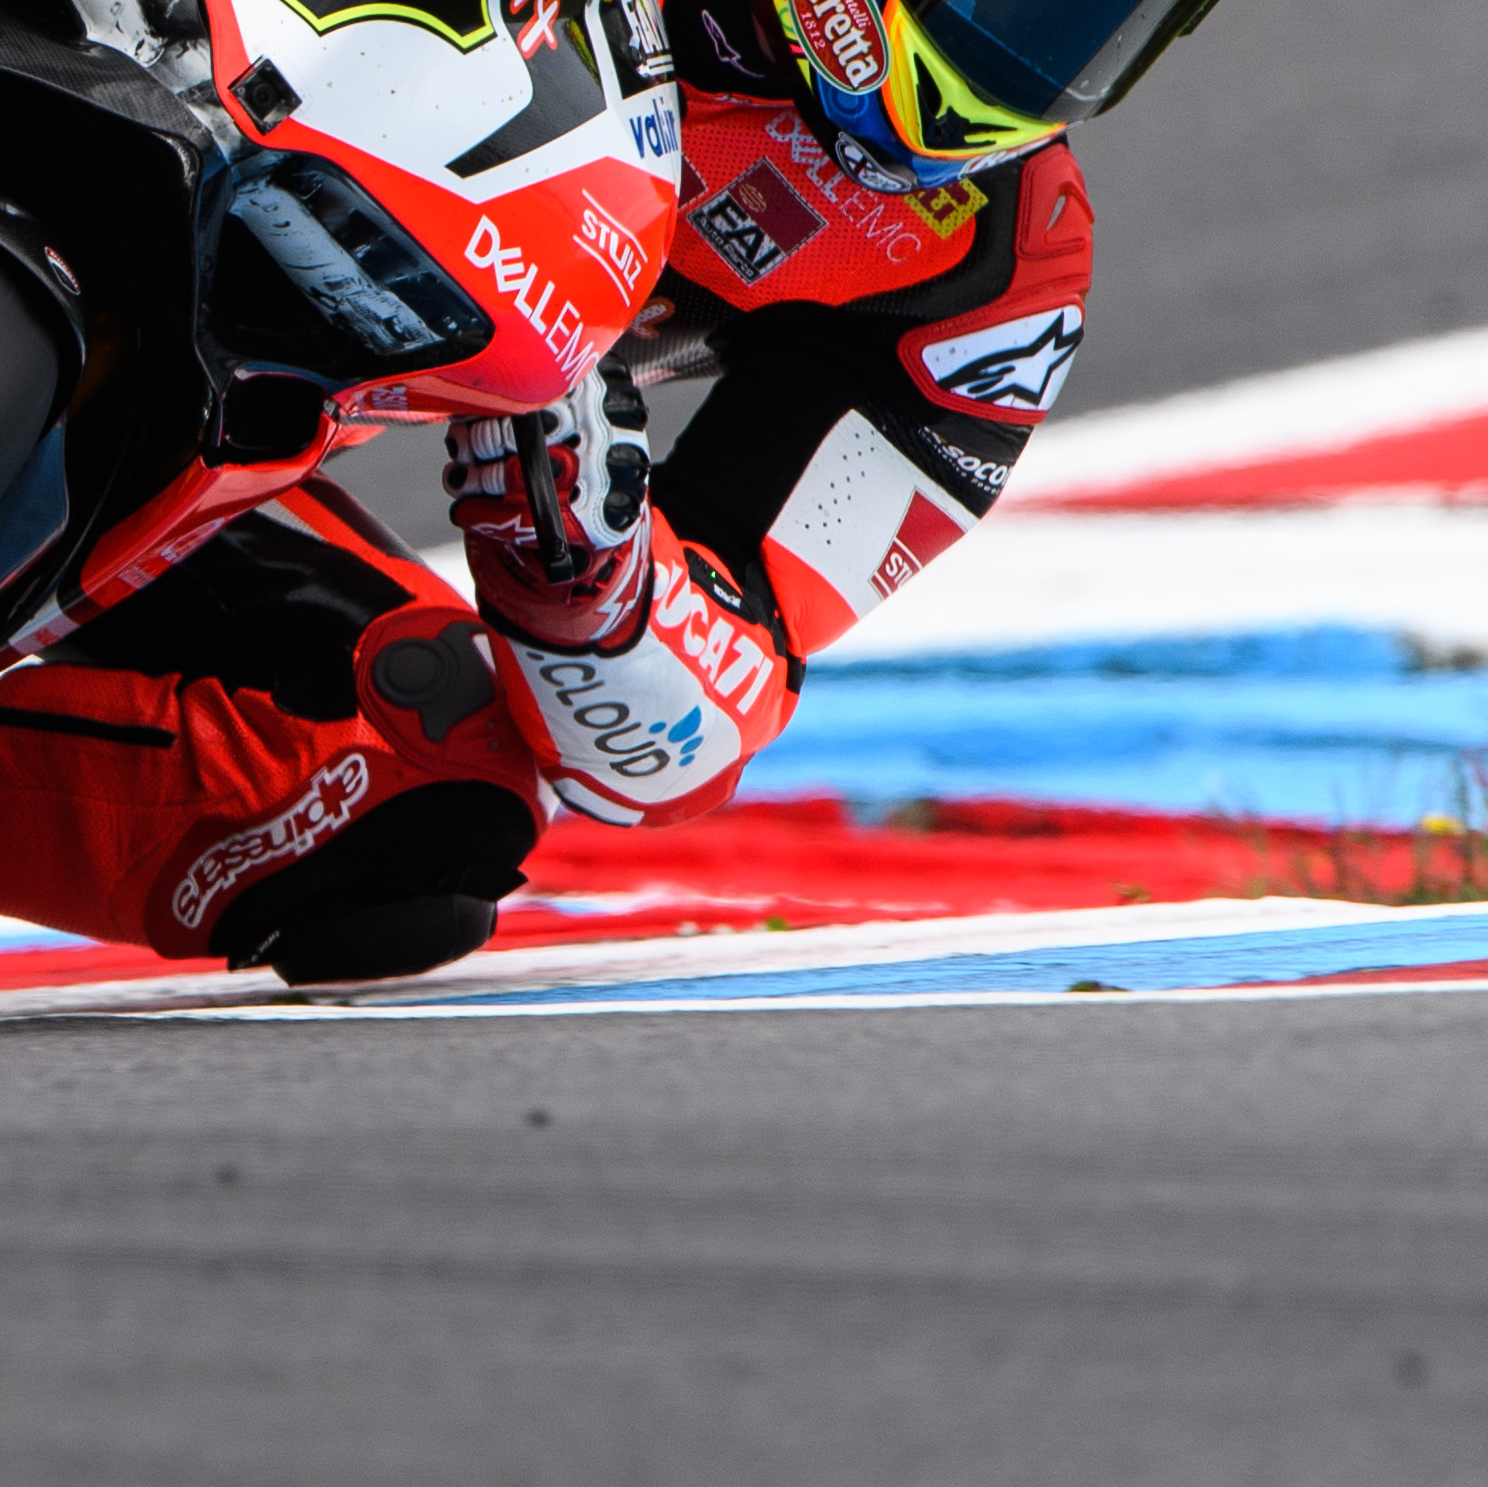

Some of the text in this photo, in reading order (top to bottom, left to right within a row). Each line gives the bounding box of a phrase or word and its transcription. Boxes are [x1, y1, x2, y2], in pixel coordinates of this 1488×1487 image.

[799, 11, 826, 51] 1812
[464, 213, 555, 336] DELL
[706, 194, 783, 264] FAI
[652, 559, 775, 716] DUCATI
[538, 661, 672, 778] CLOUD
[171, 752, 370, 930] alpinestars
